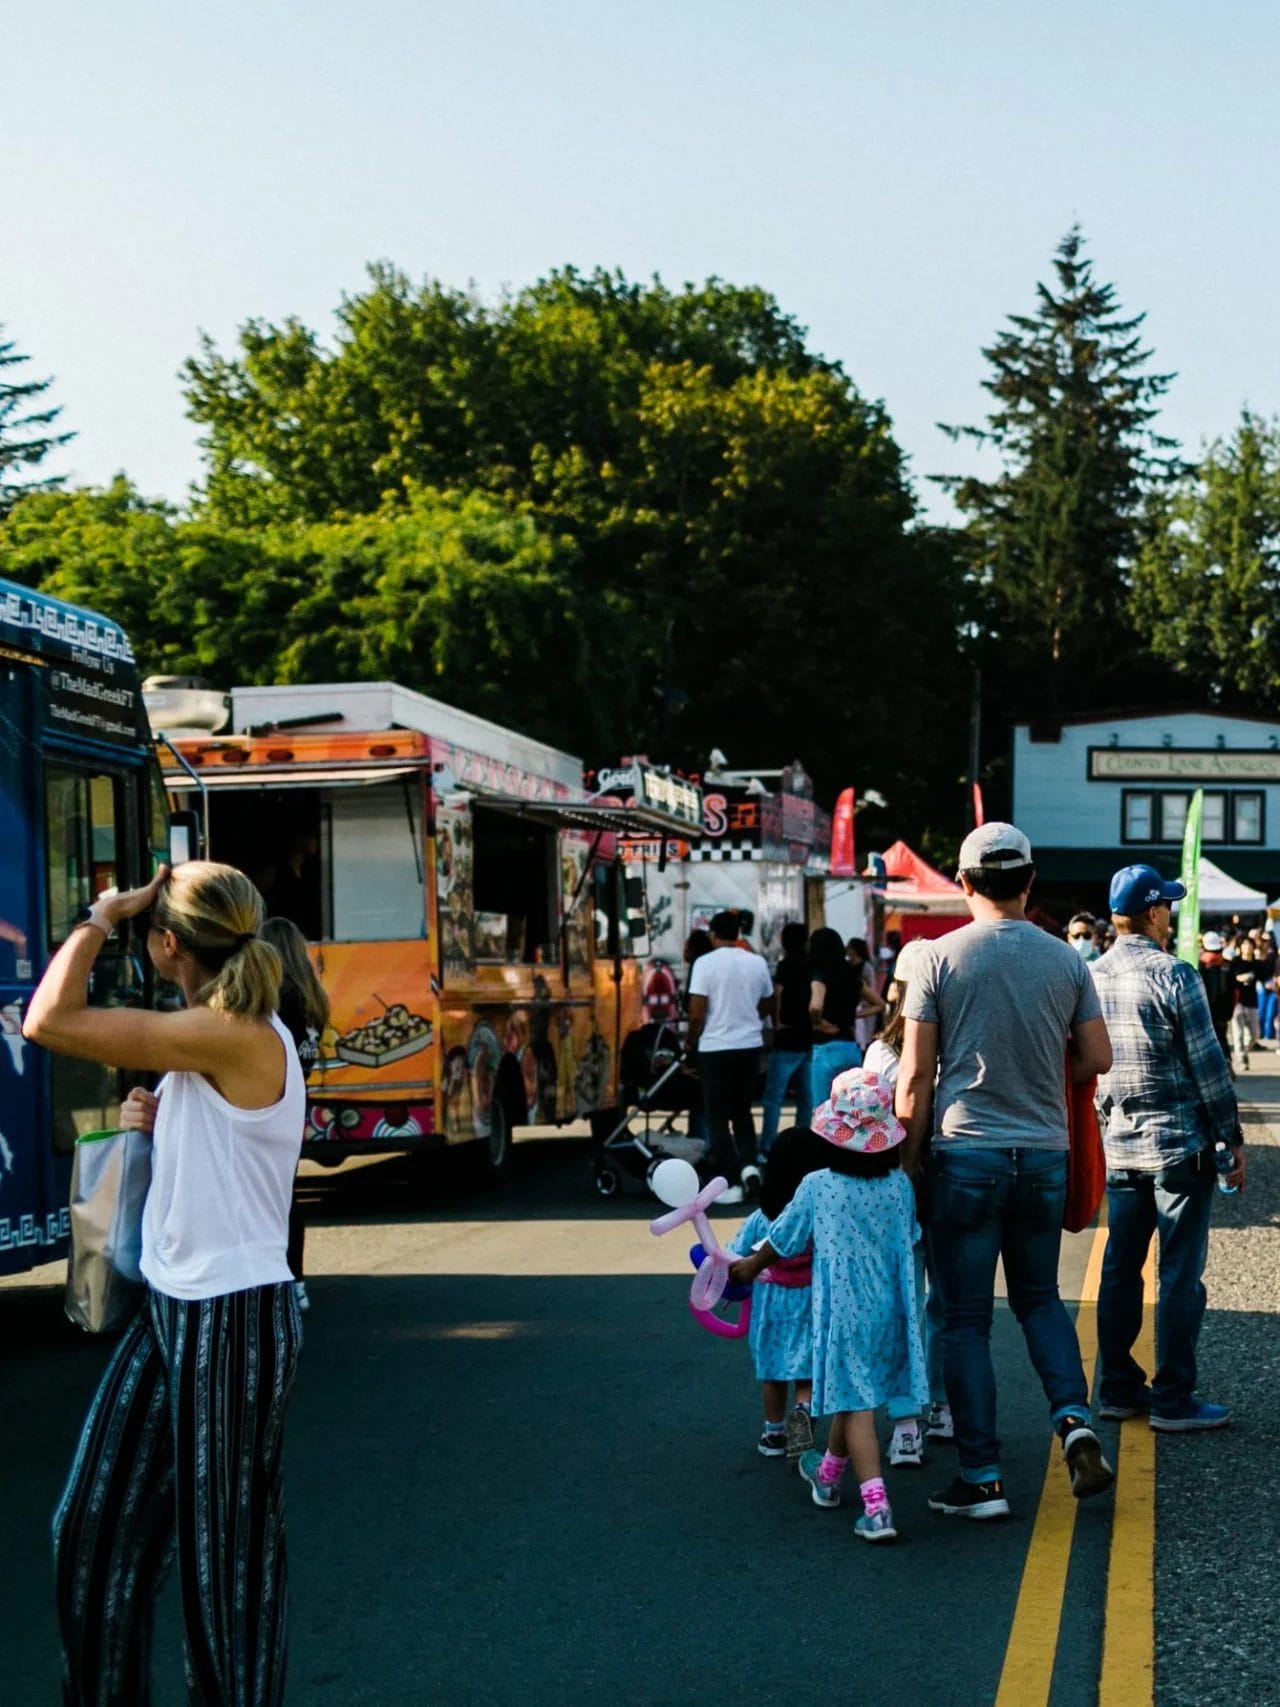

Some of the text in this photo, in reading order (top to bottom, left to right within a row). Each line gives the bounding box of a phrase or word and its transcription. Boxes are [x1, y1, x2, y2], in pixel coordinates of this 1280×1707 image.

[71, 646, 114, 675] Follow Us
[632, 842, 678, 855] FRIS
